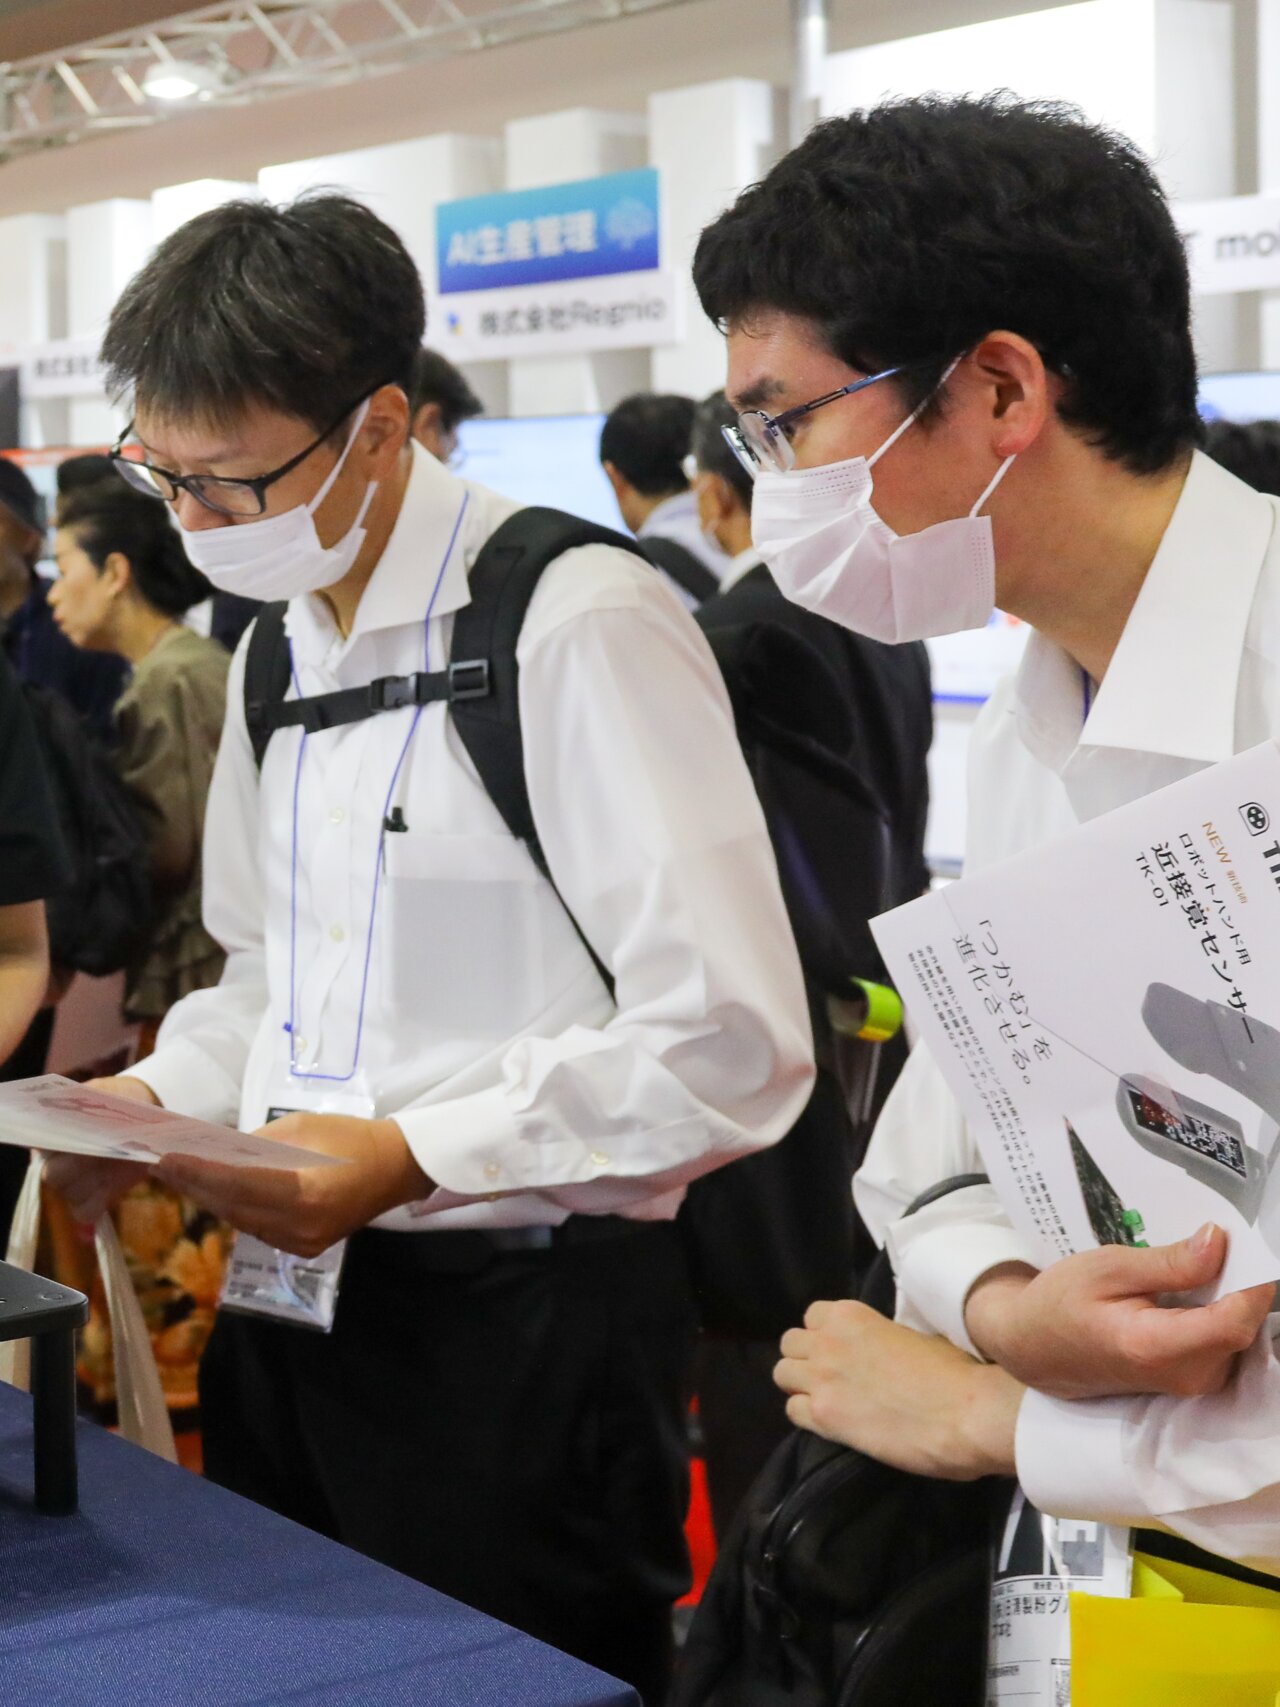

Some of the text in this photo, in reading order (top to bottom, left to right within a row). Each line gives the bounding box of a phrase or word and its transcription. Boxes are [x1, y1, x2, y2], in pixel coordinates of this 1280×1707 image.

[1136, 852, 1169, 906] TK-01
[1179, 833, 1251, 965] ロボットハンド用
[1202, 821, 1232, 863] NEW
[952, 934, 1031, 1085] 進化させる。
[979, 920, 1052, 1061] 「つかむ」を
[1150, 841, 1255, 1044] 近接覚センサー
